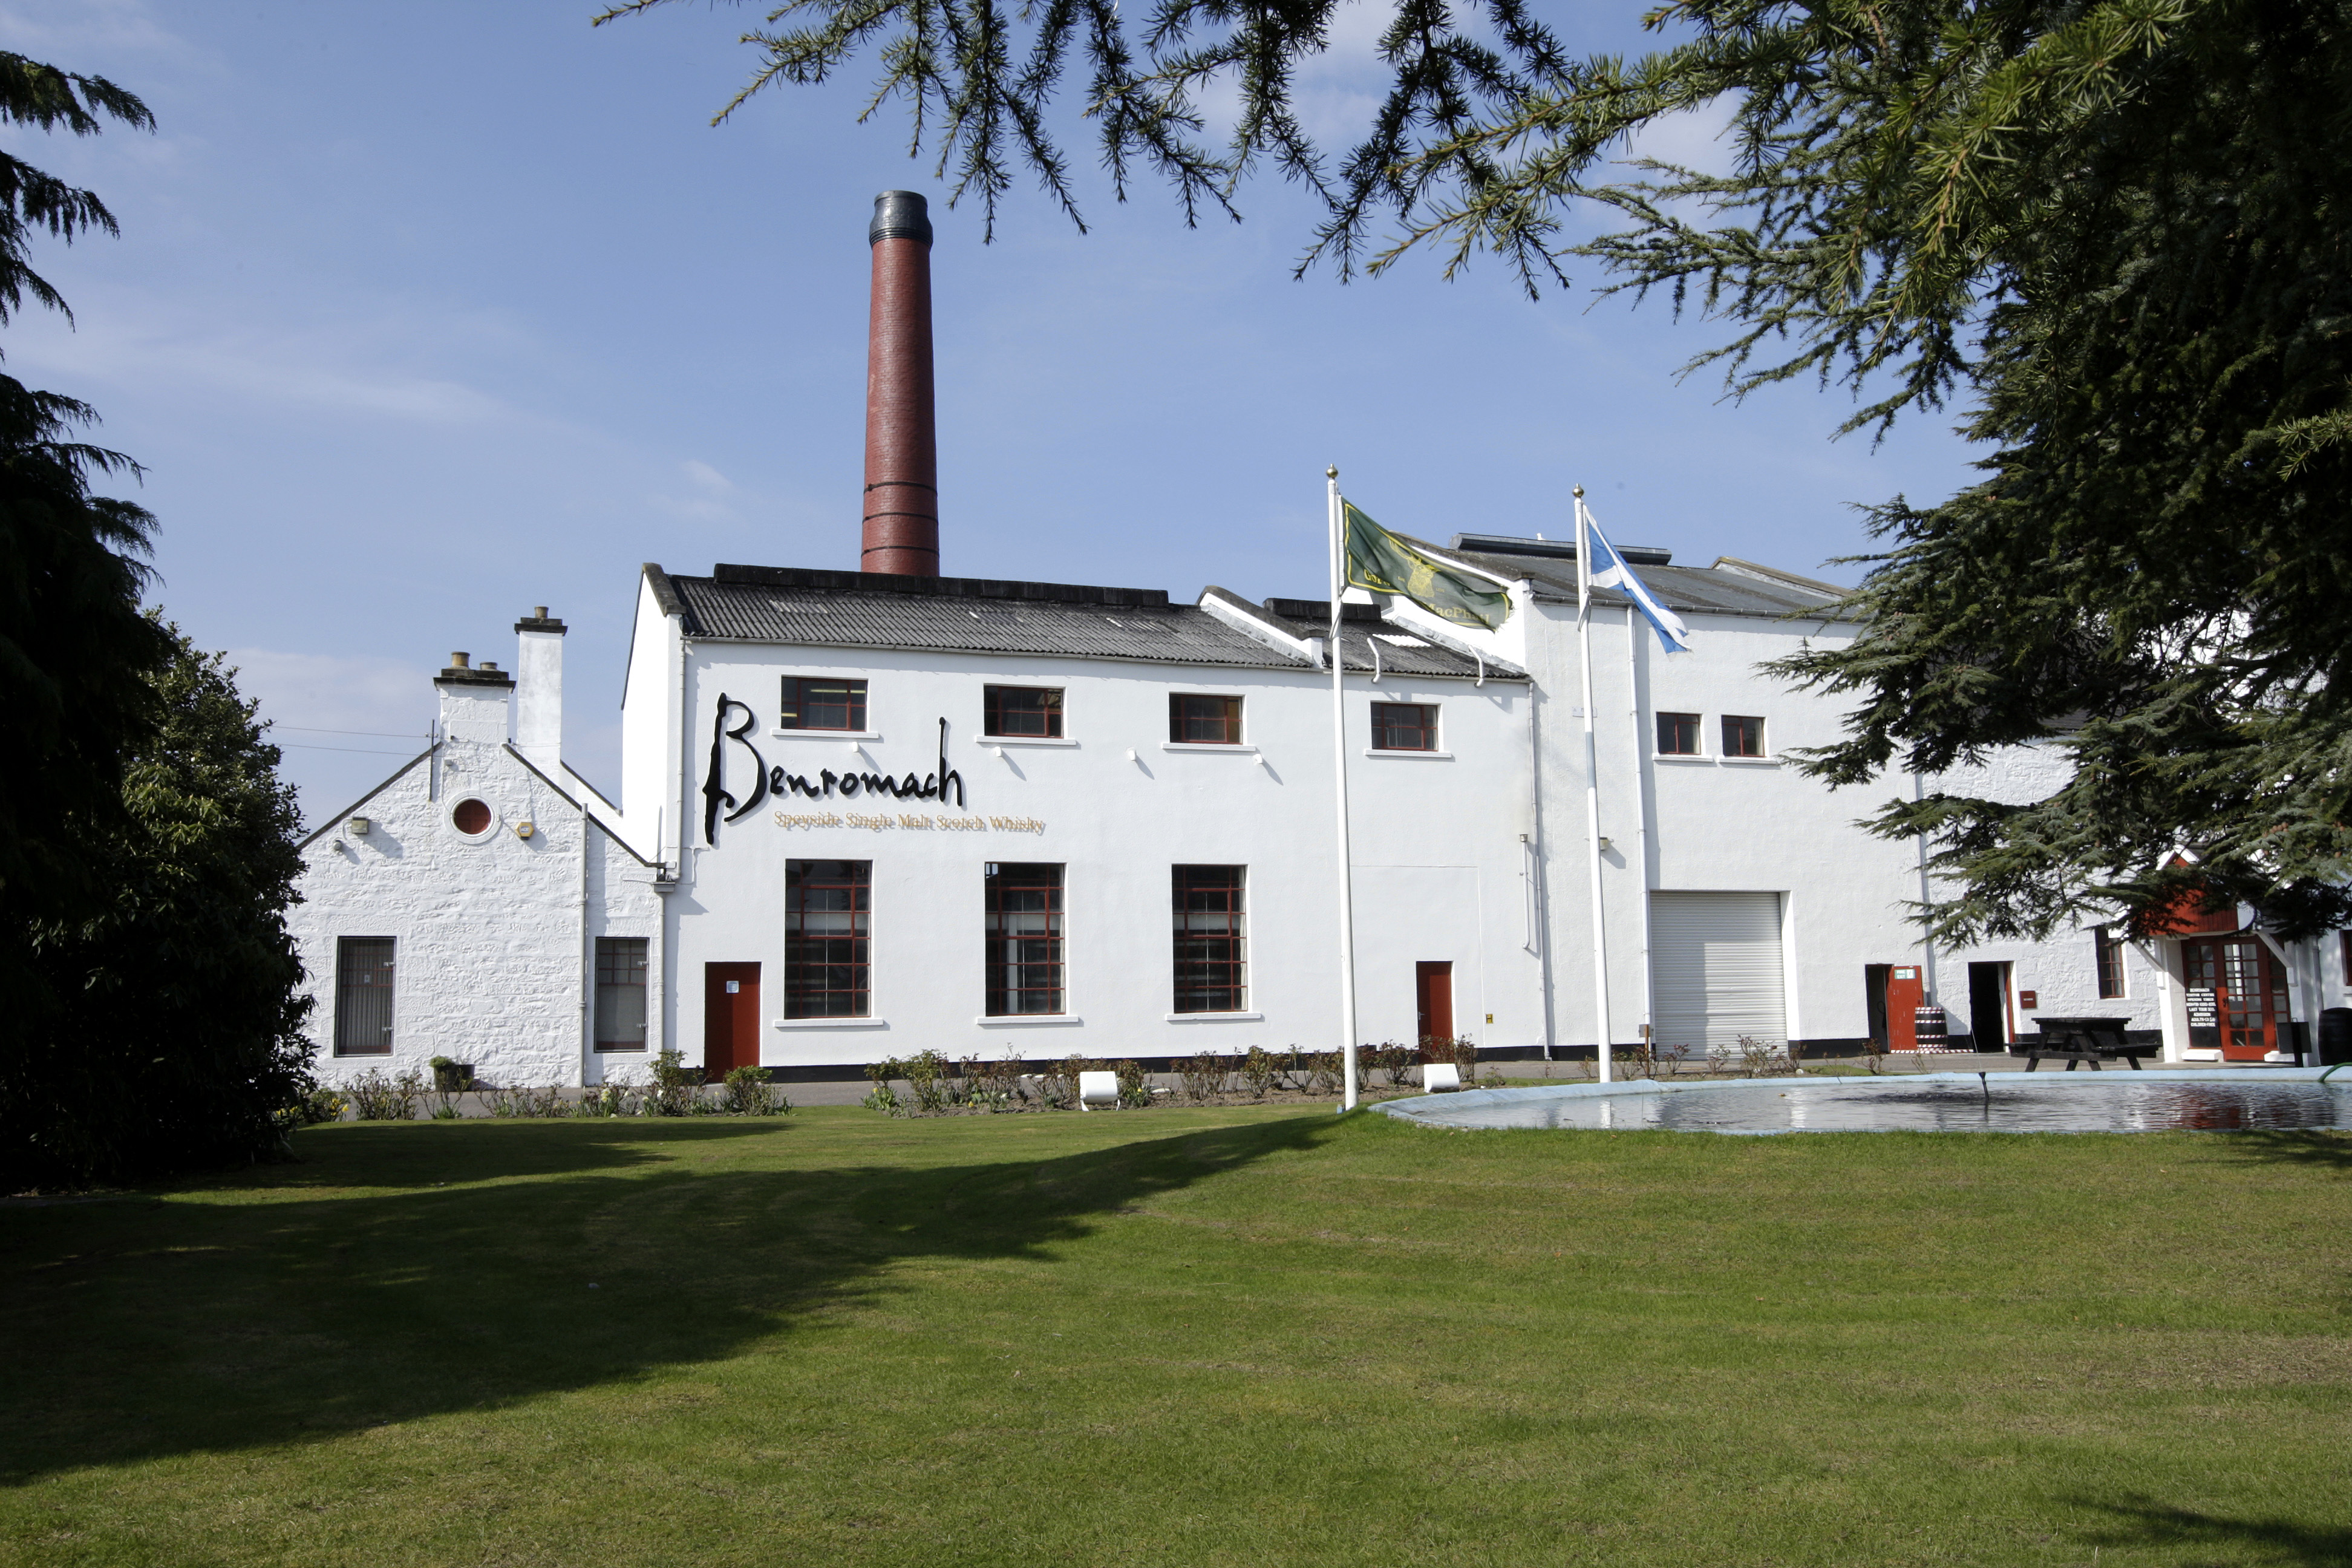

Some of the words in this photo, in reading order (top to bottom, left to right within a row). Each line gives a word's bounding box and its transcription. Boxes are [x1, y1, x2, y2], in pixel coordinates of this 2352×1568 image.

[702, 692, 963, 845] Benromach
[774, 811, 840, 828] Speyside
[846, 812, 892, 829] Single
[897, 814, 931, 828] Malt
[936, 814, 984, 828] Scotch
[988, 815, 1043, 832] Whisky
